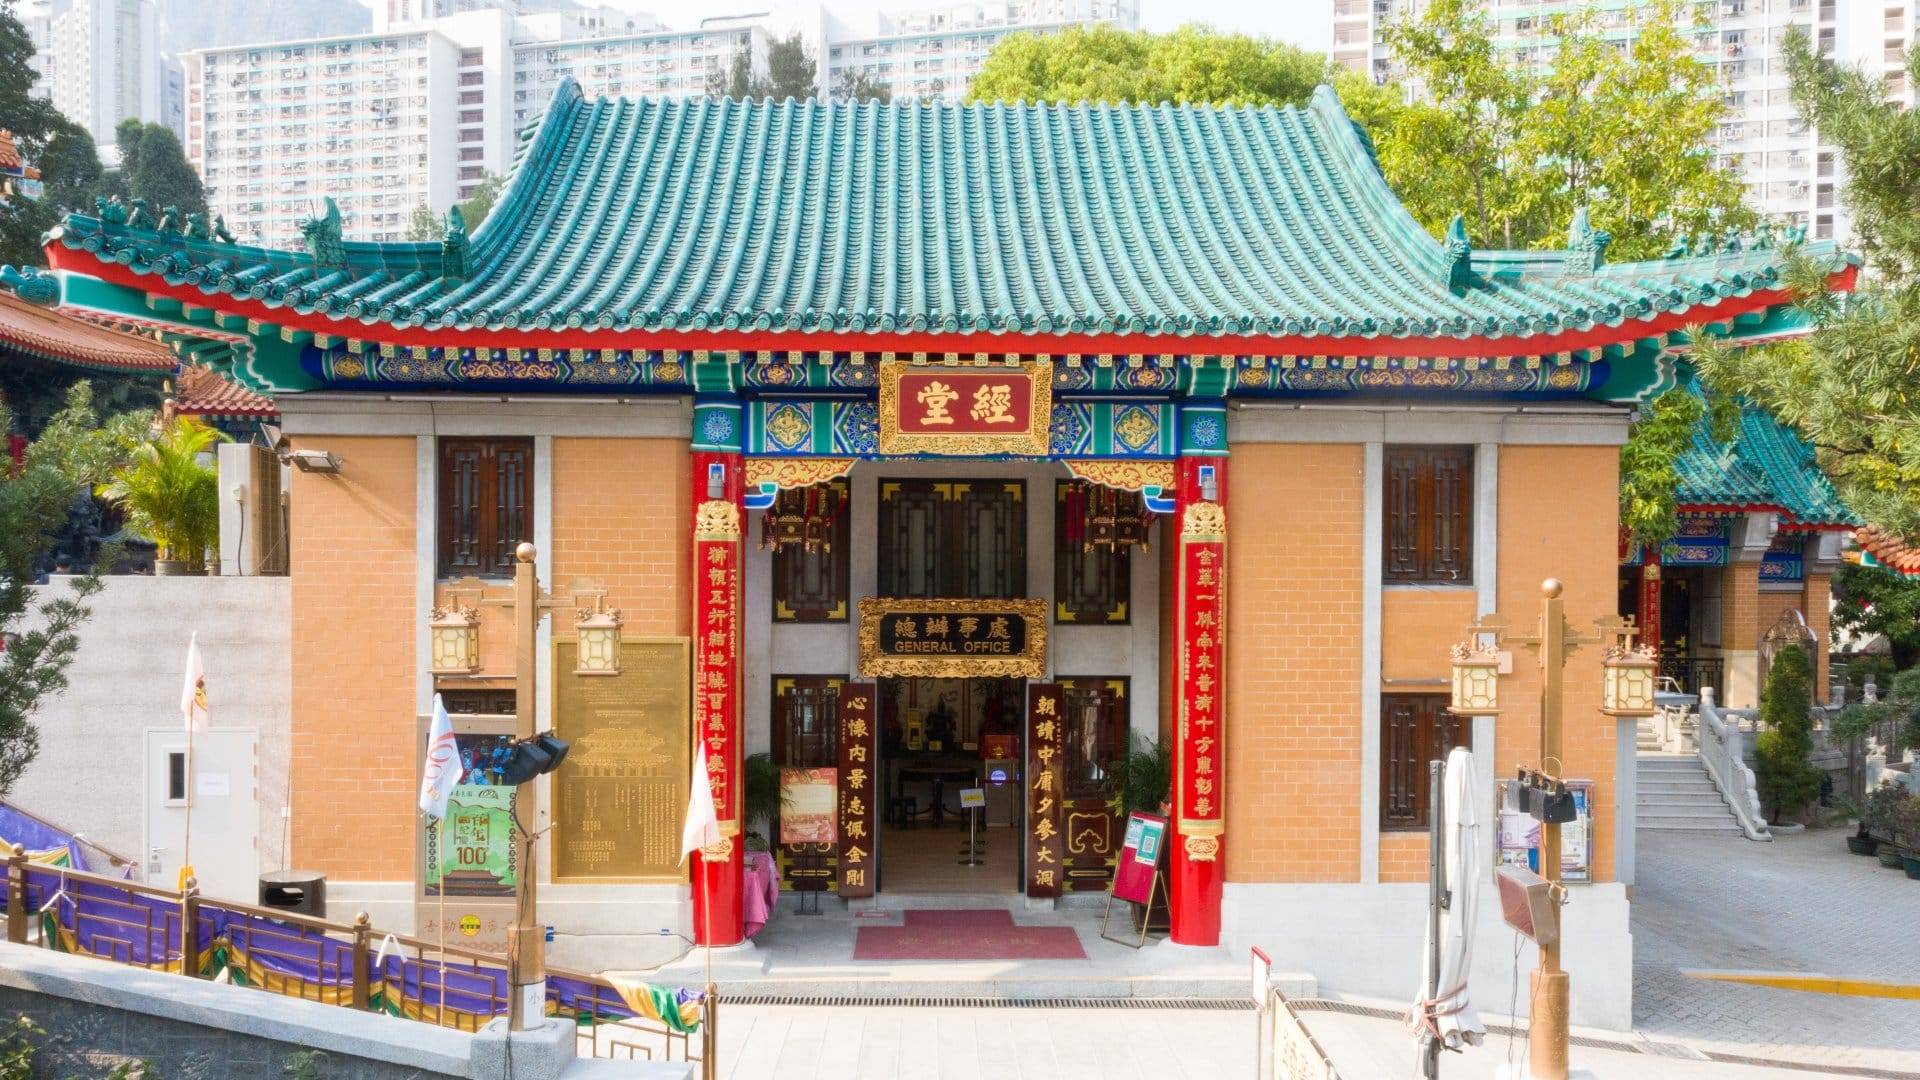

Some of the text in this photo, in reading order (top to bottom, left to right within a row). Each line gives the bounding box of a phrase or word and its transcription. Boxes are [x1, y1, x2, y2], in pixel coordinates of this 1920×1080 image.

[894, 615, 1011, 640] 總辦事處
[895, 641, 1010, 653] GENERAL OFFICE
[456, 847, 487, 865] 100
